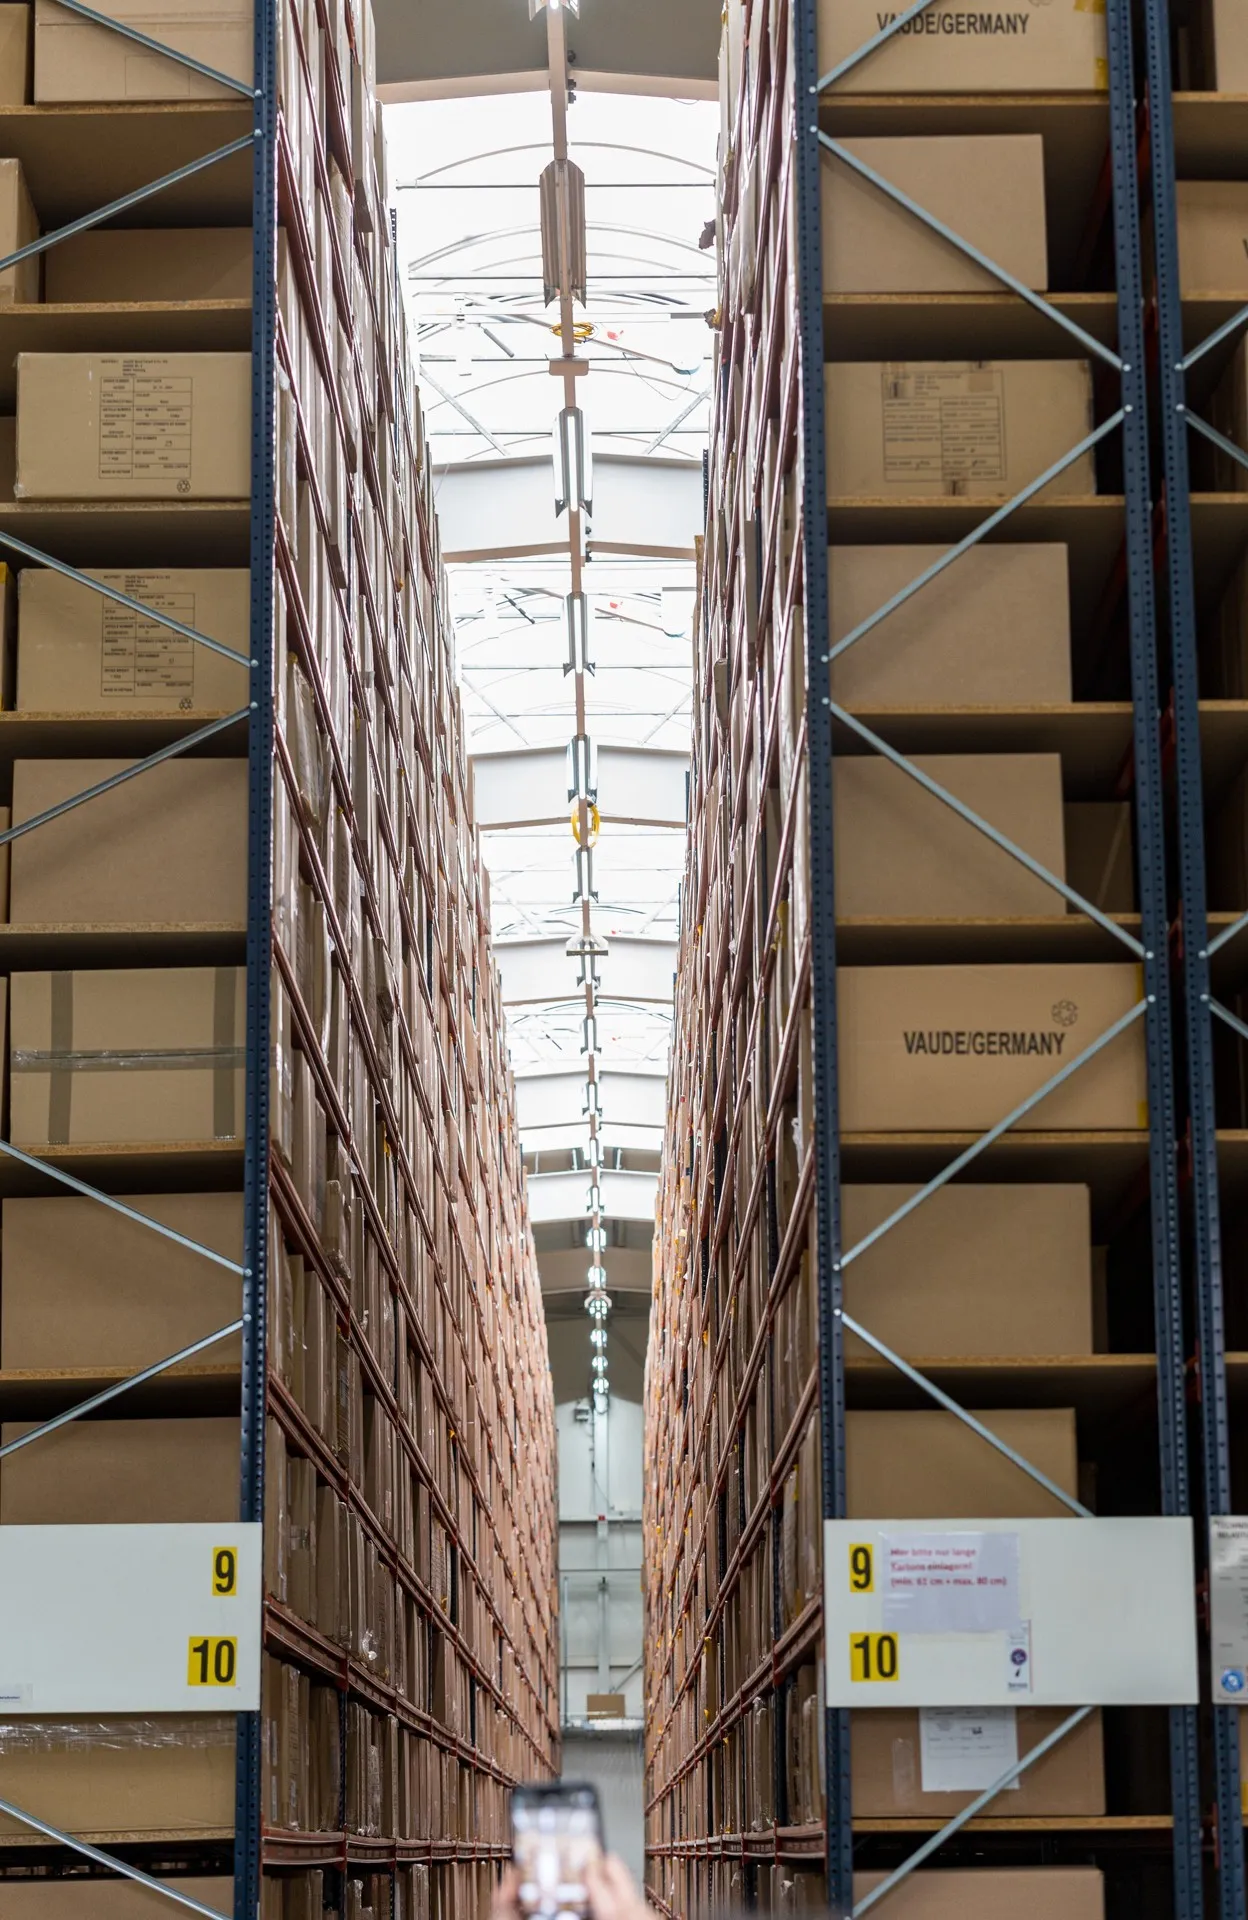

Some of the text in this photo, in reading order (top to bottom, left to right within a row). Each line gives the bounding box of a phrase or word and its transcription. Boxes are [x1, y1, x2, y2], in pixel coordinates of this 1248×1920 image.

[903, 1031, 1066, 1055] VAUDE/GERMANY
[215, 1550, 235, 1593] 9
[851, 1546, 872, 1589] 9
[952, 1548, 976, 1557] lange
[989, 1577, 1007, 1586] cm)
[193, 1639, 235, 1683] 10
[854, 1635, 896, 1679] 10
